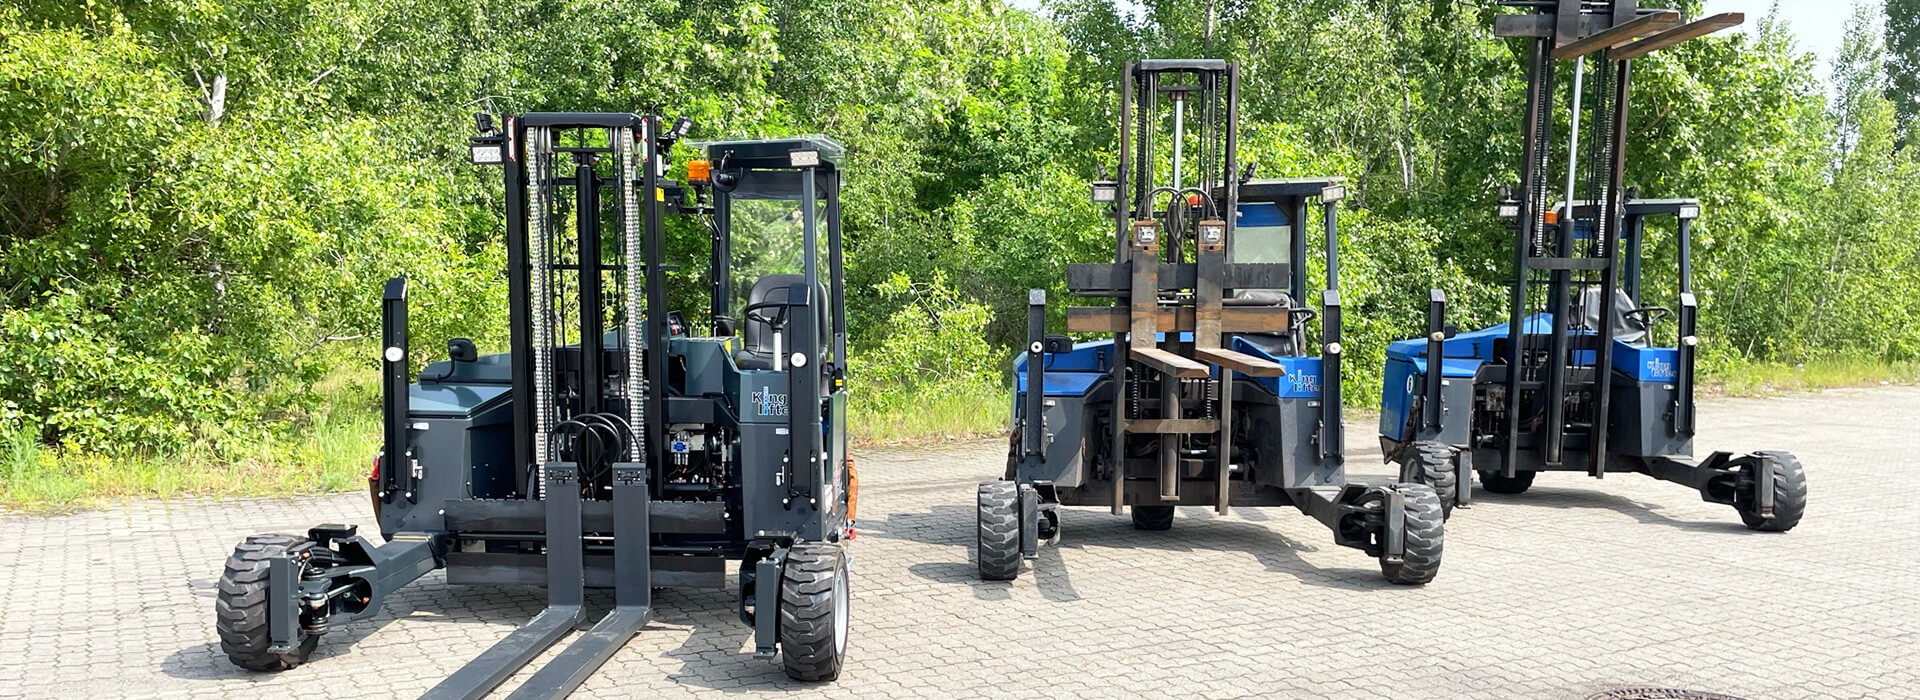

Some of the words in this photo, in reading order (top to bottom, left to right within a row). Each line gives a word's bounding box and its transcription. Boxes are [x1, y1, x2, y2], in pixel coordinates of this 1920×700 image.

[1288, 369, 1317, 385] King
[752, 386, 788, 406] King
[757, 403, 789, 416] lifte
